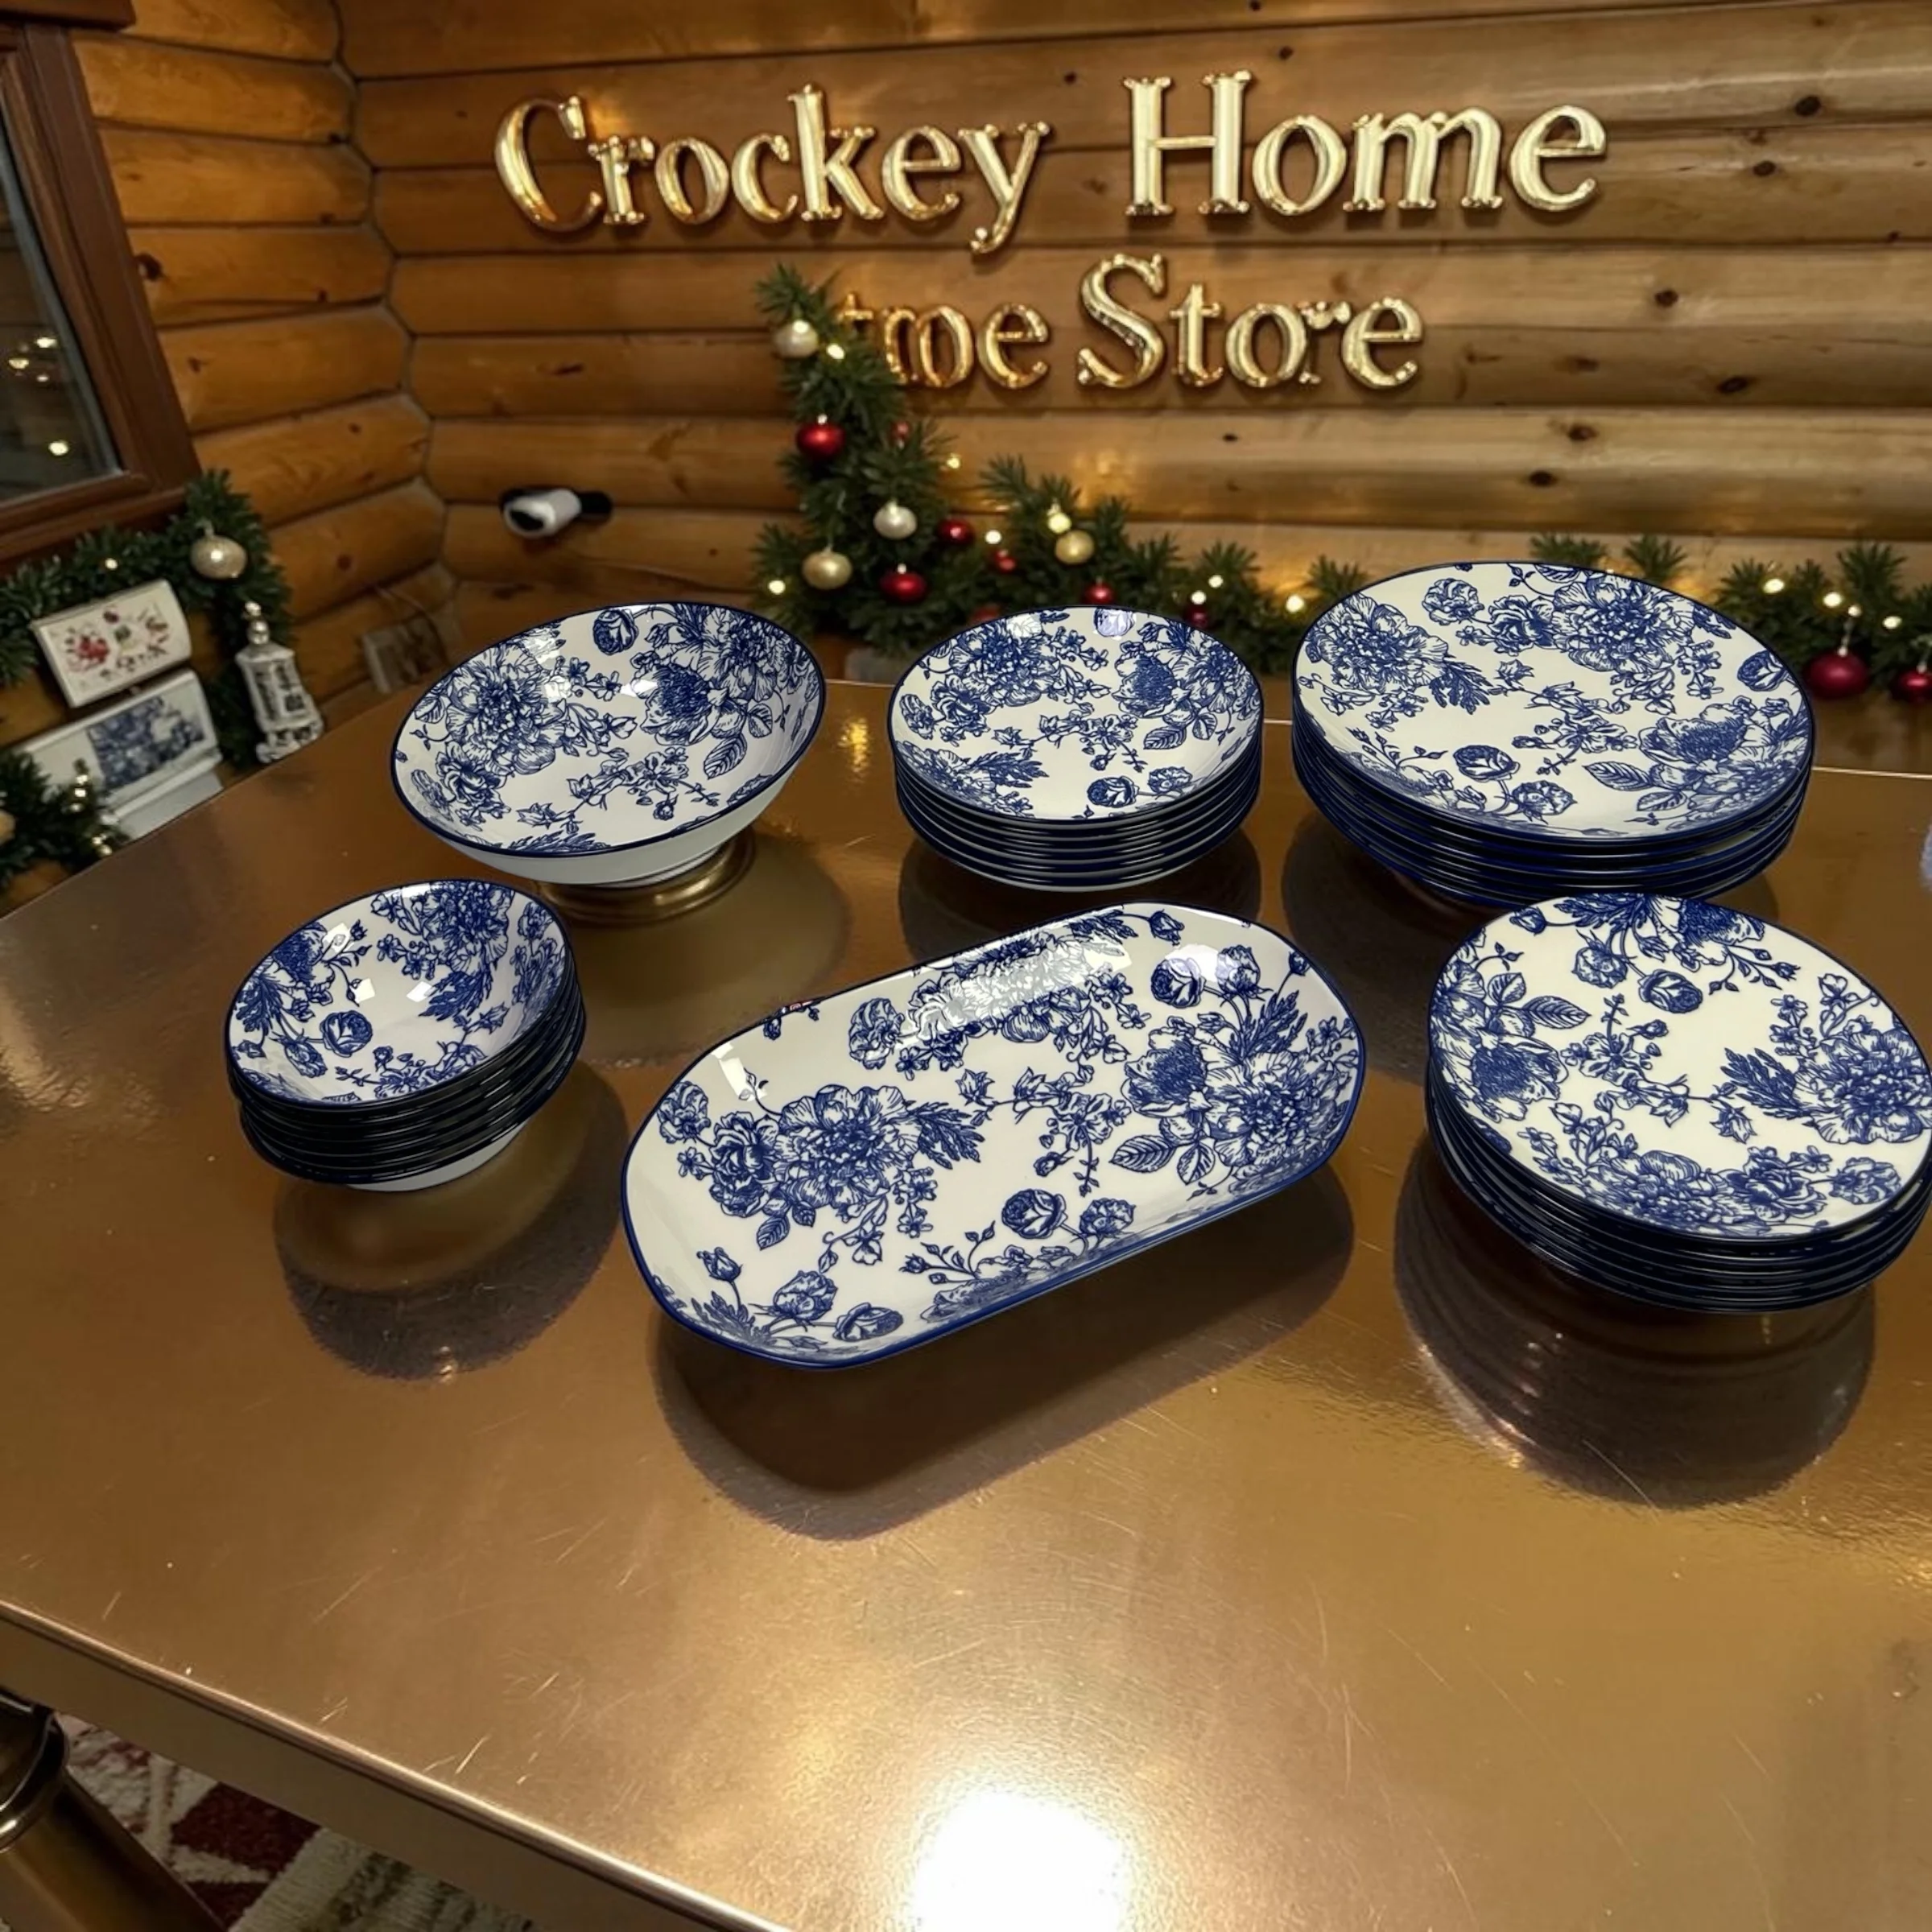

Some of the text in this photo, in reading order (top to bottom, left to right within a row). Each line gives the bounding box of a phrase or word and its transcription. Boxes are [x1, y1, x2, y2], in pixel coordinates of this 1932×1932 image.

[494, 69, 1606, 254] Crockey Home
[1078, 254, 1422, 389] Store
